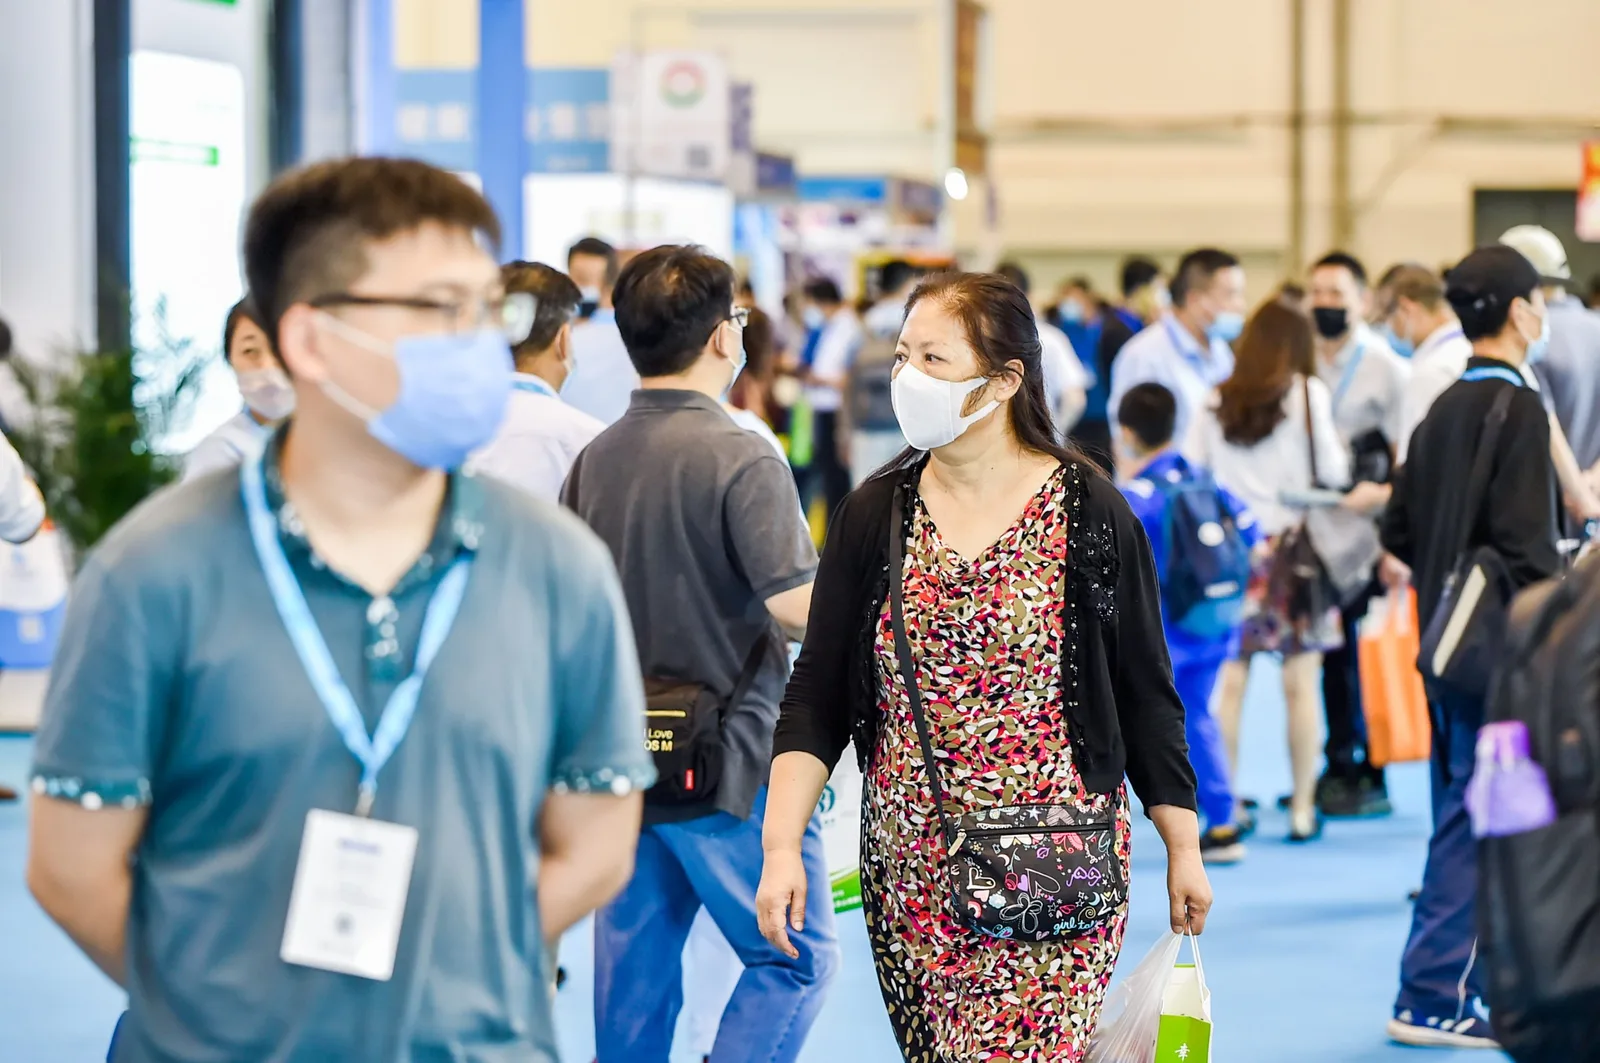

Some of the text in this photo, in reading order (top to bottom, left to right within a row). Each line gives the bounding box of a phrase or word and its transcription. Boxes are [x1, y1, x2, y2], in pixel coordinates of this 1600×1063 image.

[648, 727, 673, 739] Love
[1053, 916, 1077, 935] girl
[1077, 919, 1099, 930] tal
